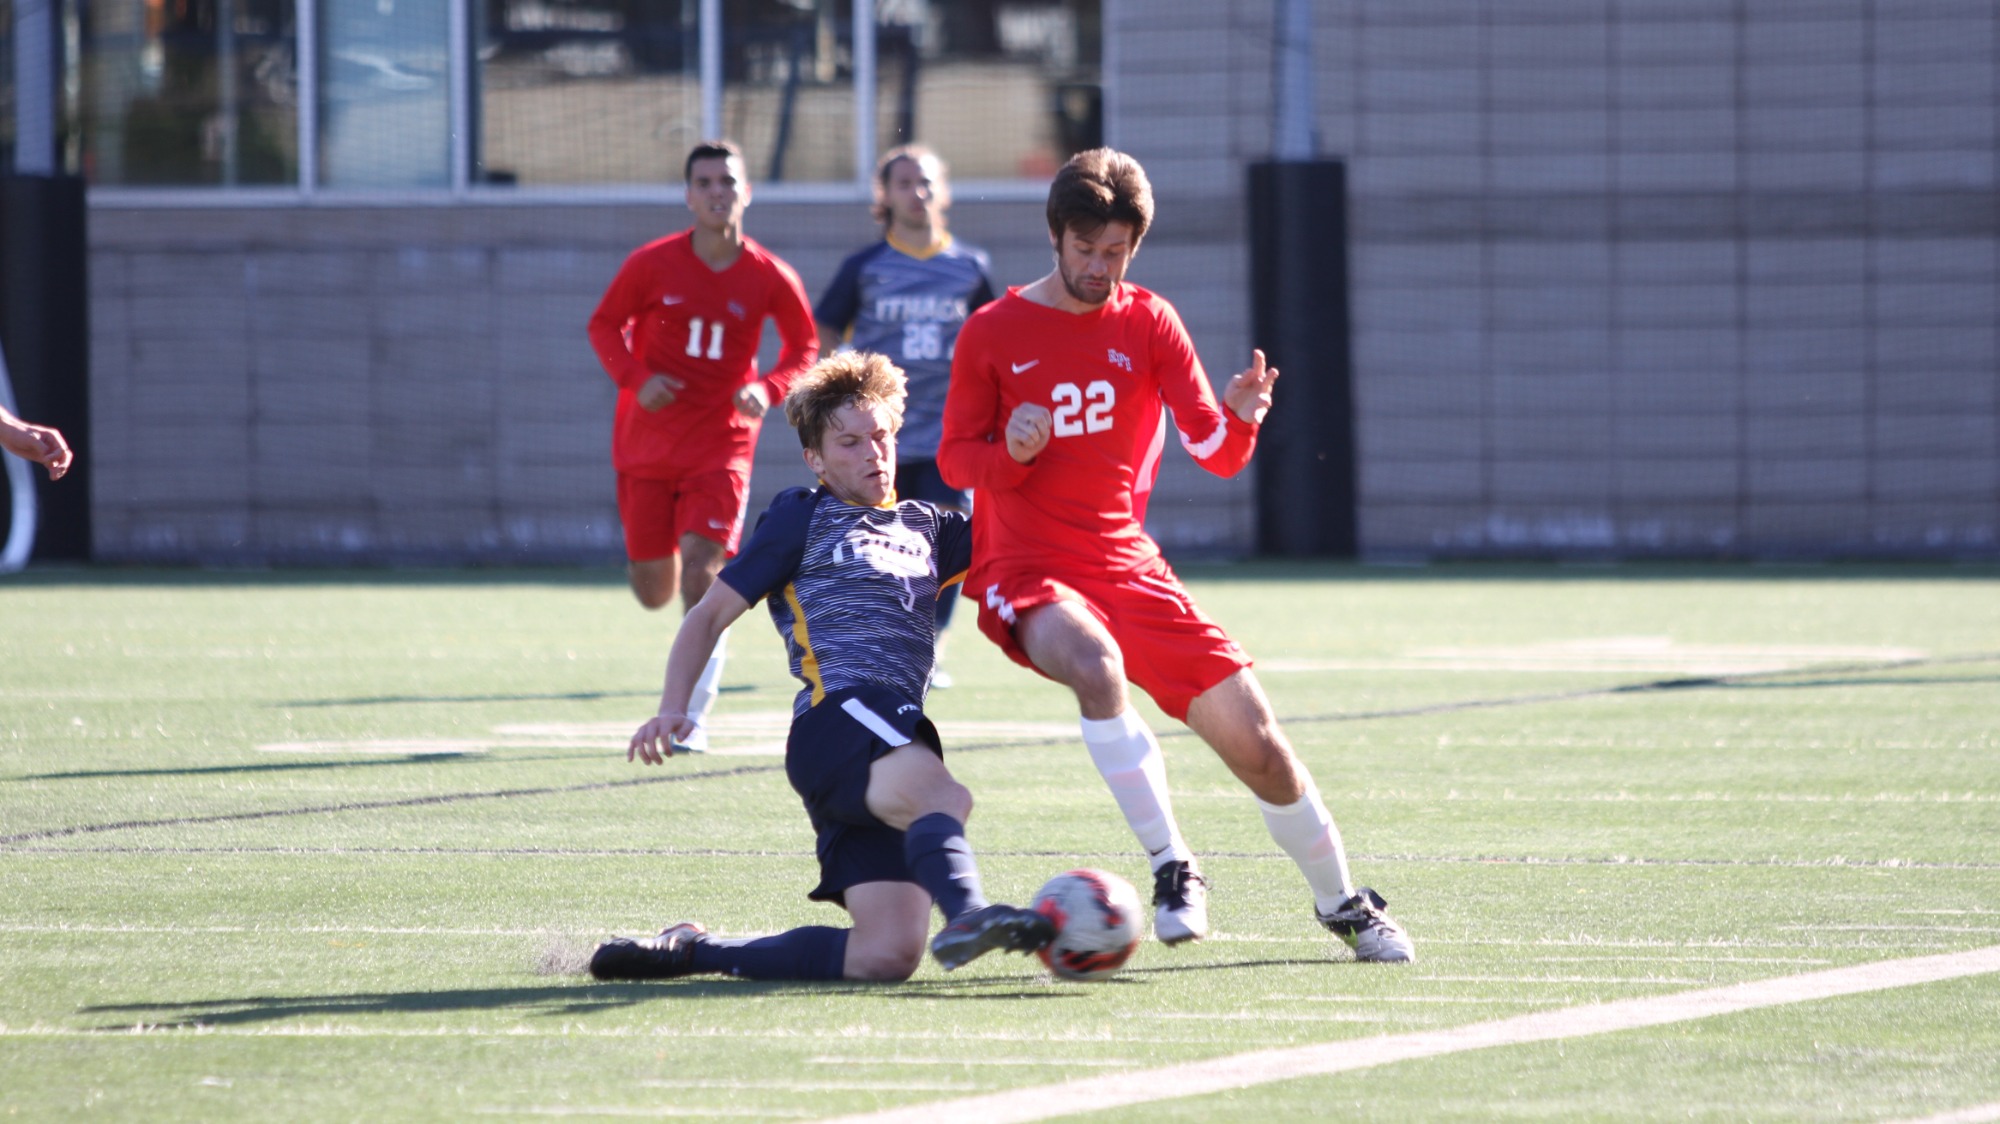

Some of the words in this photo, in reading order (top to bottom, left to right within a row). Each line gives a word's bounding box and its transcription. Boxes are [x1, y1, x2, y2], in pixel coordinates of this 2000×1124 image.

[686, 317, 724, 360] 11
[902, 322, 941, 360] 26
[1051, 380, 1115, 438] 22
